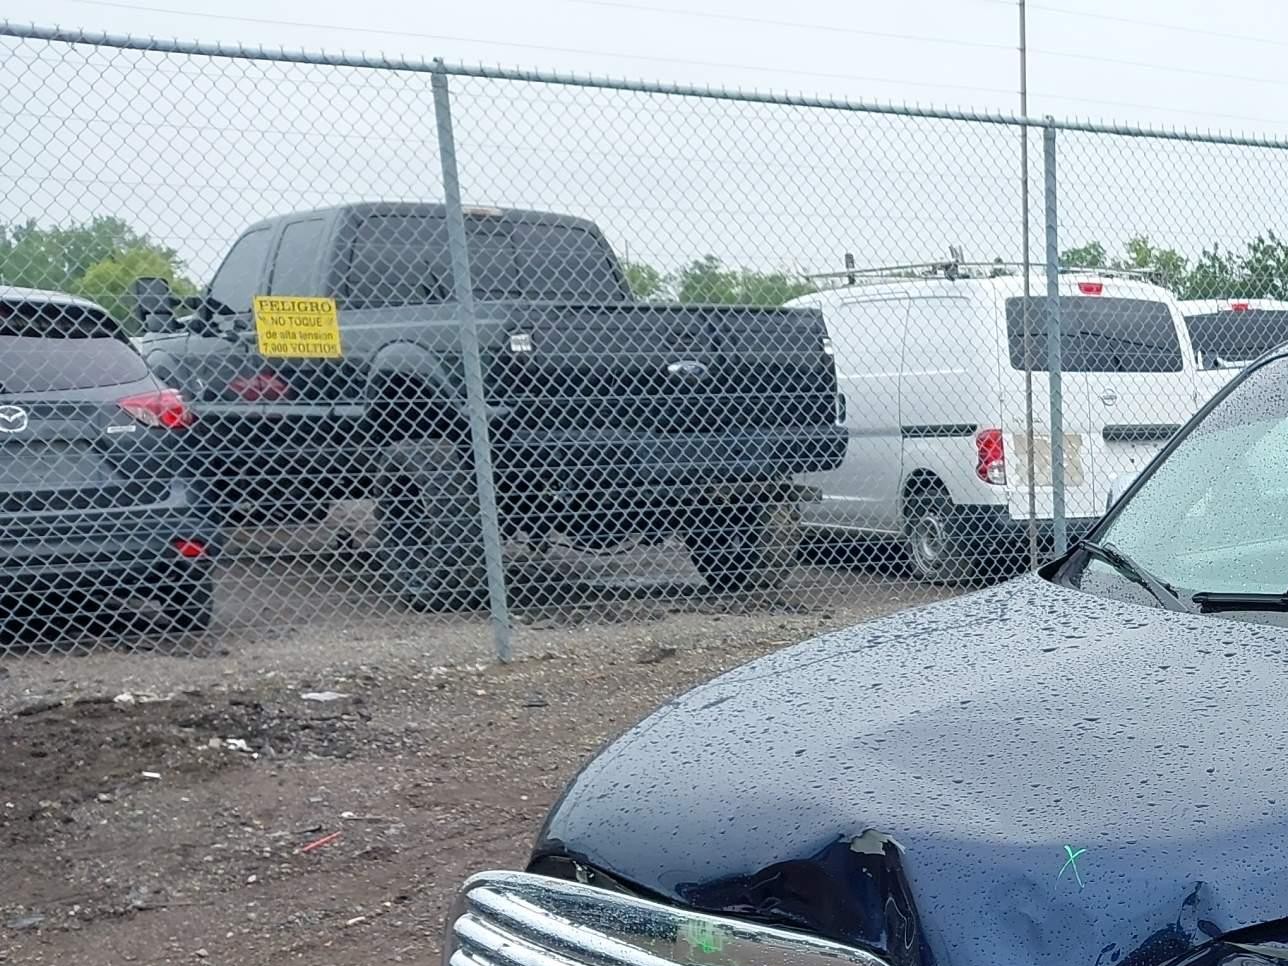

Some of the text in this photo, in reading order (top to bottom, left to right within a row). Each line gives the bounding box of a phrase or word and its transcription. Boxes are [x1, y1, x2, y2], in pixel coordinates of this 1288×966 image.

[258, 300, 332, 313] PELIGRO
[271, 316, 323, 327] NO TOQUE
[265, 330, 277, 340] de
